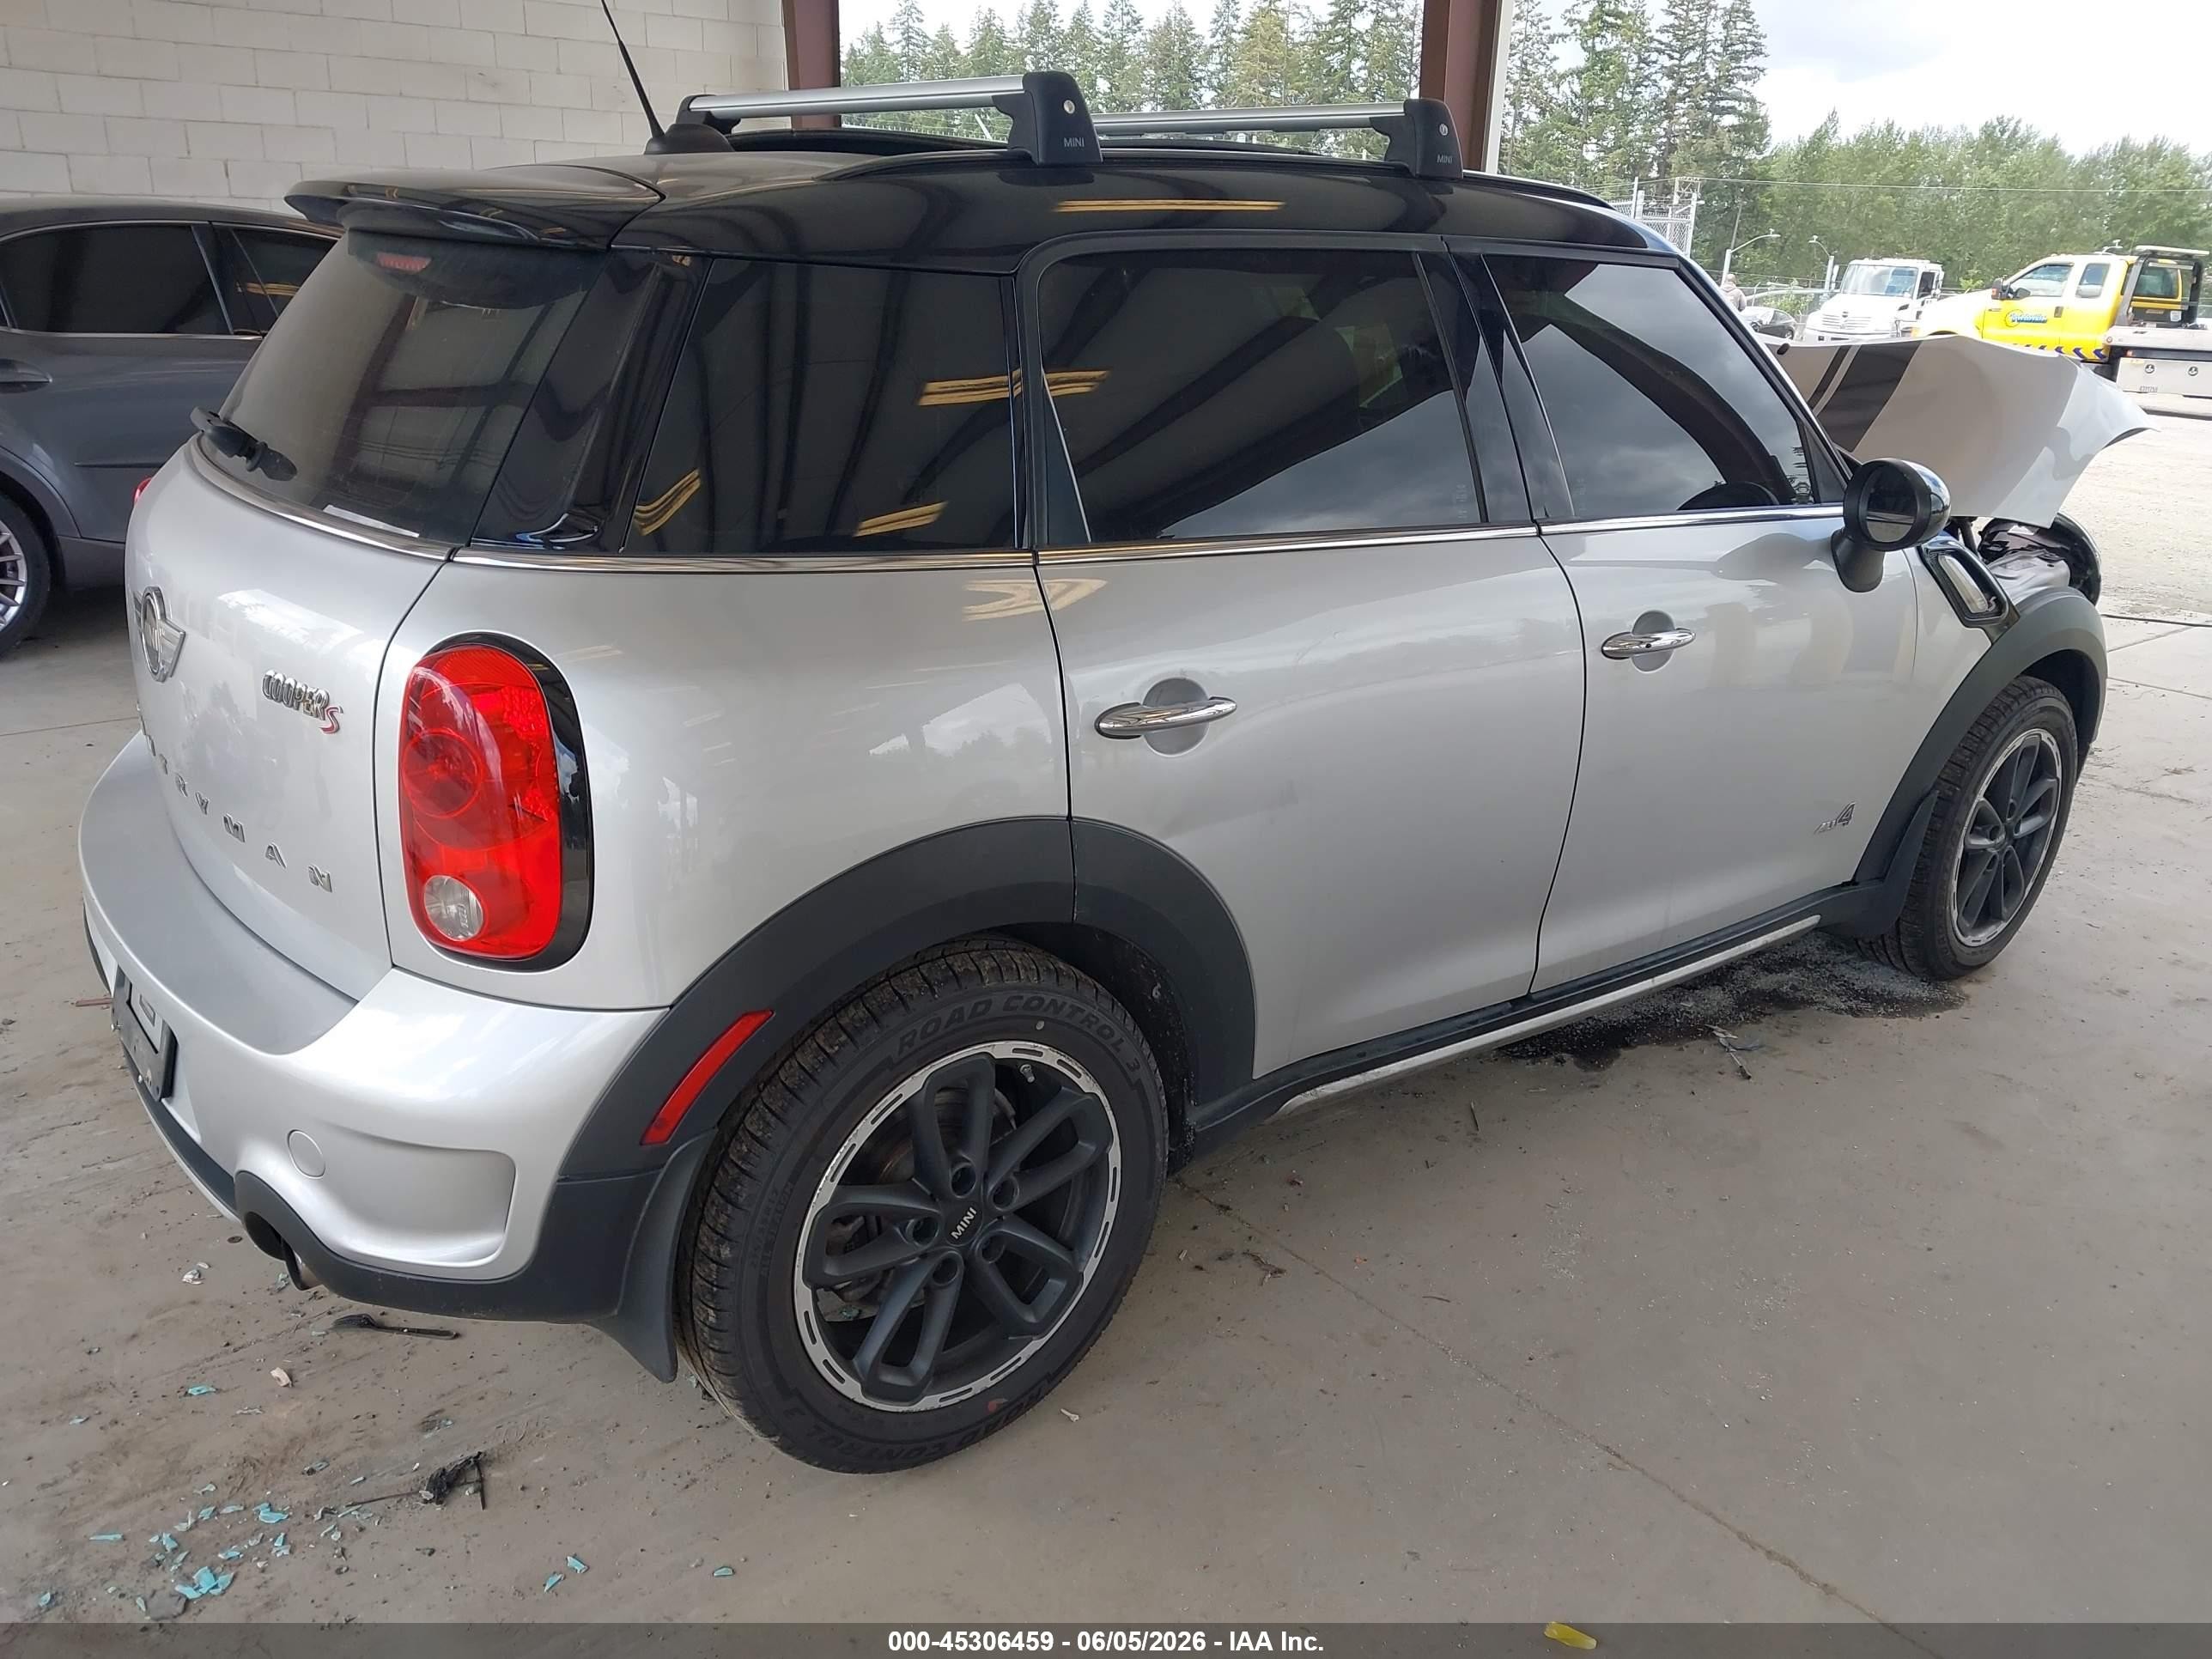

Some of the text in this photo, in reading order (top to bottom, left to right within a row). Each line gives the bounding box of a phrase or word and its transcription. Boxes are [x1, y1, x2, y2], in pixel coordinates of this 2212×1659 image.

[1063, 137, 1085, 147] MINI
[1437, 155, 1453, 163] MINI
[897, 995, 1141, 1073] ROAD CONTROL 3
[951, 1206, 977, 1239] MINI
